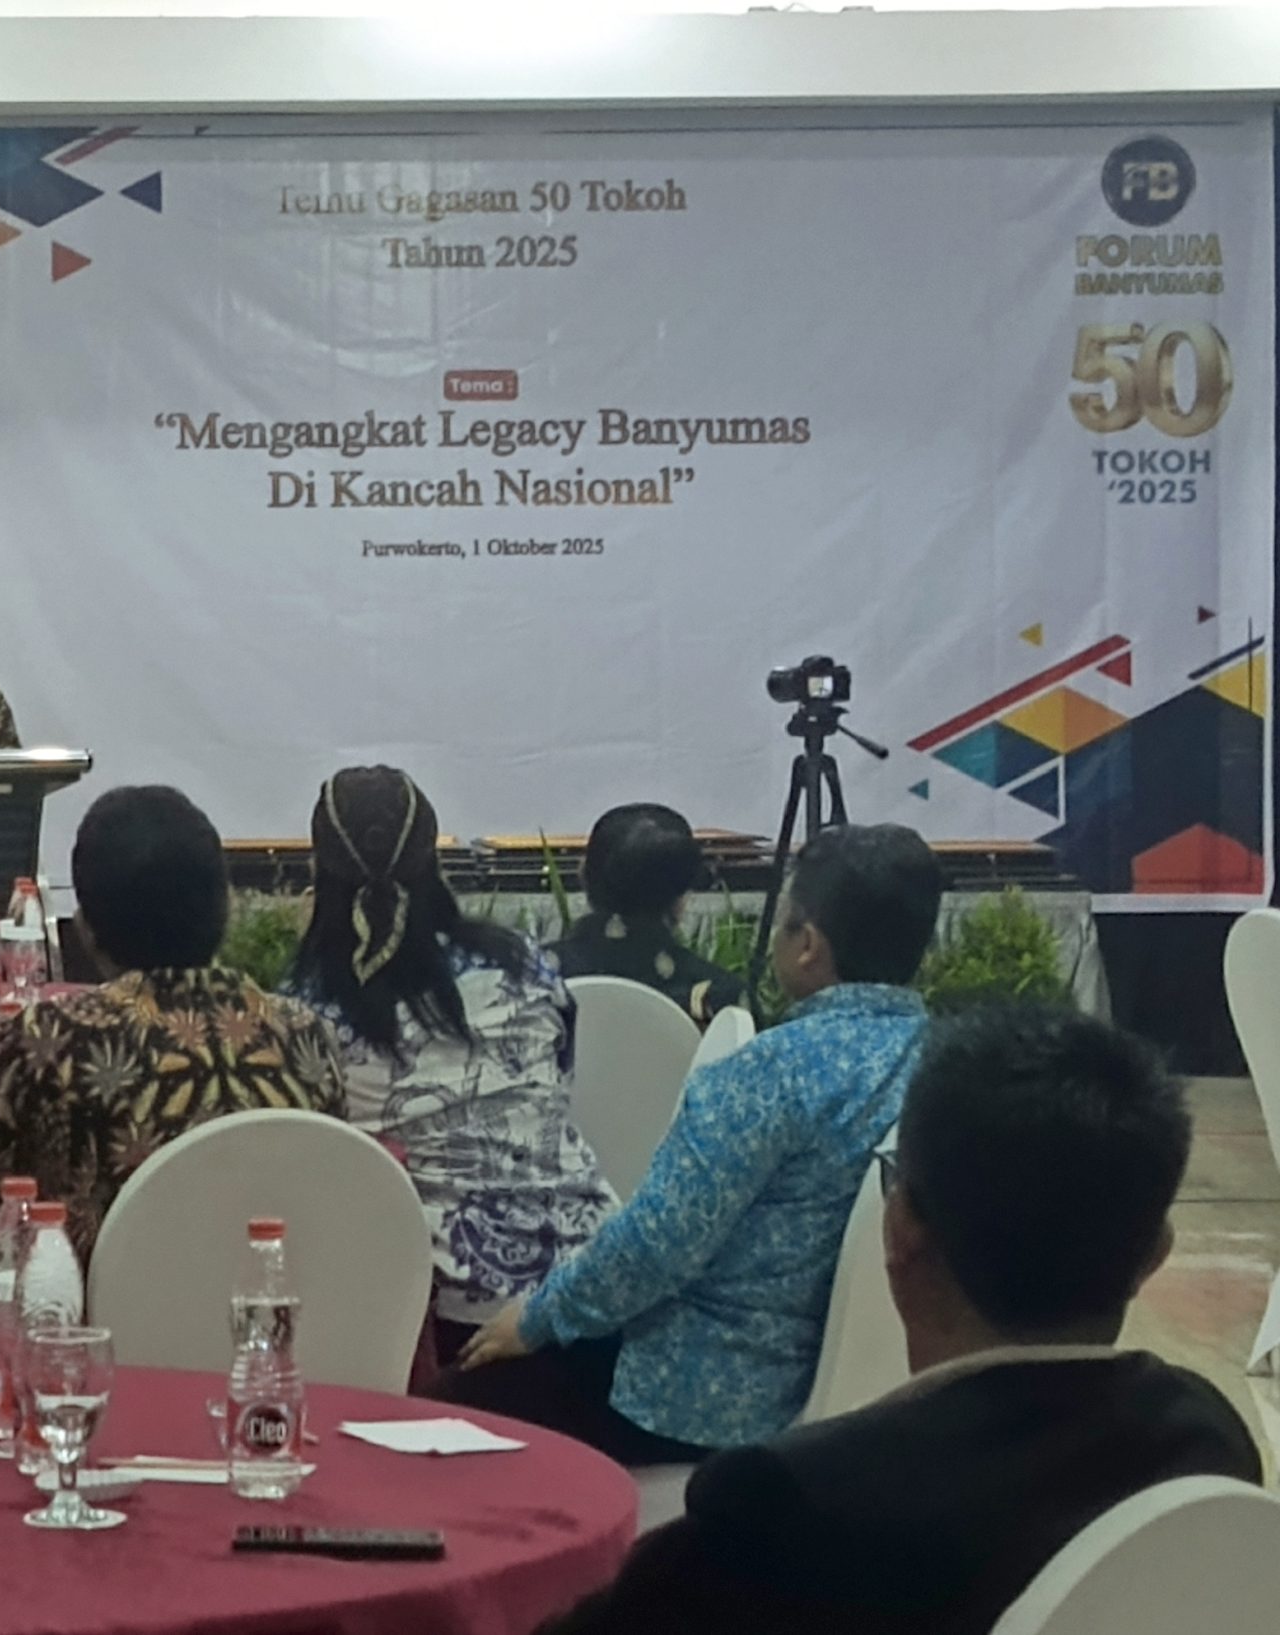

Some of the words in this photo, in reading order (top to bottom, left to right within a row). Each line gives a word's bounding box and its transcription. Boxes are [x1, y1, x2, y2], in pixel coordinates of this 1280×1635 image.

[1122, 161, 1179, 200] FB
[378, 184, 518, 222] Gagasan
[529, 181, 571, 213] 50
[581, 180, 687, 212] Tokoh
[383, 236, 485, 268] Tahun
[495, 236, 578, 267] 2025
[1075, 233, 1223, 268] FORUM
[1074, 271, 1224, 295] BANYUMAS
[1069, 321, 1233, 438] 50
[438, 409, 586, 456] Legacy
[598, 408, 812, 454] Banyumas
[1092, 450, 1211, 474] TOKOH
[267, 470, 317, 508] Di
[329, 468, 484, 508] Kancah
[362, 540, 466, 560] Purwokerto,
[473, 540, 481, 556] 1
[487, 539, 557, 556] Oktober
[561, 538, 605, 556] 2025
